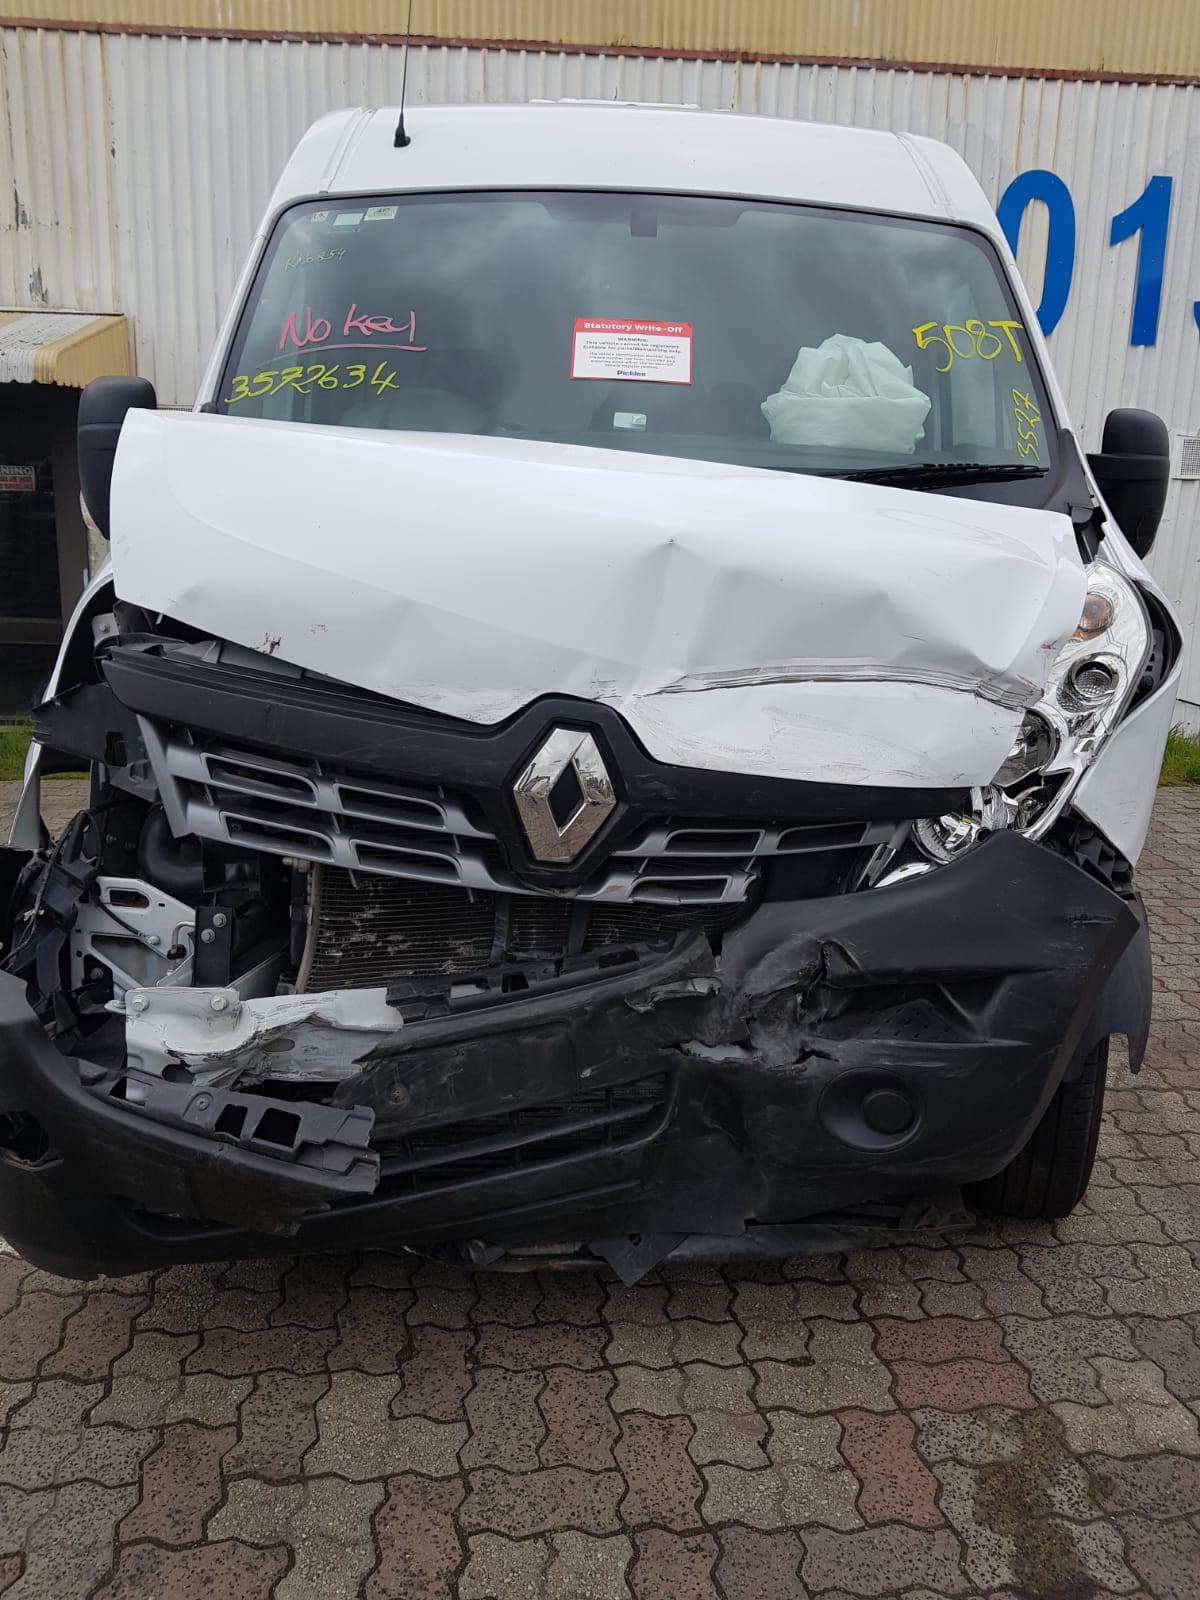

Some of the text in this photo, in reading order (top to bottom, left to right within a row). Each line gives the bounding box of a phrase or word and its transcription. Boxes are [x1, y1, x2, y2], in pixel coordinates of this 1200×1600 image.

[996, 169, 1200, 346] 01
[279, 306, 332, 349] No
[583, 322, 683, 333] Statutory Write-Off
[912, 319, 1024, 373] 508T
